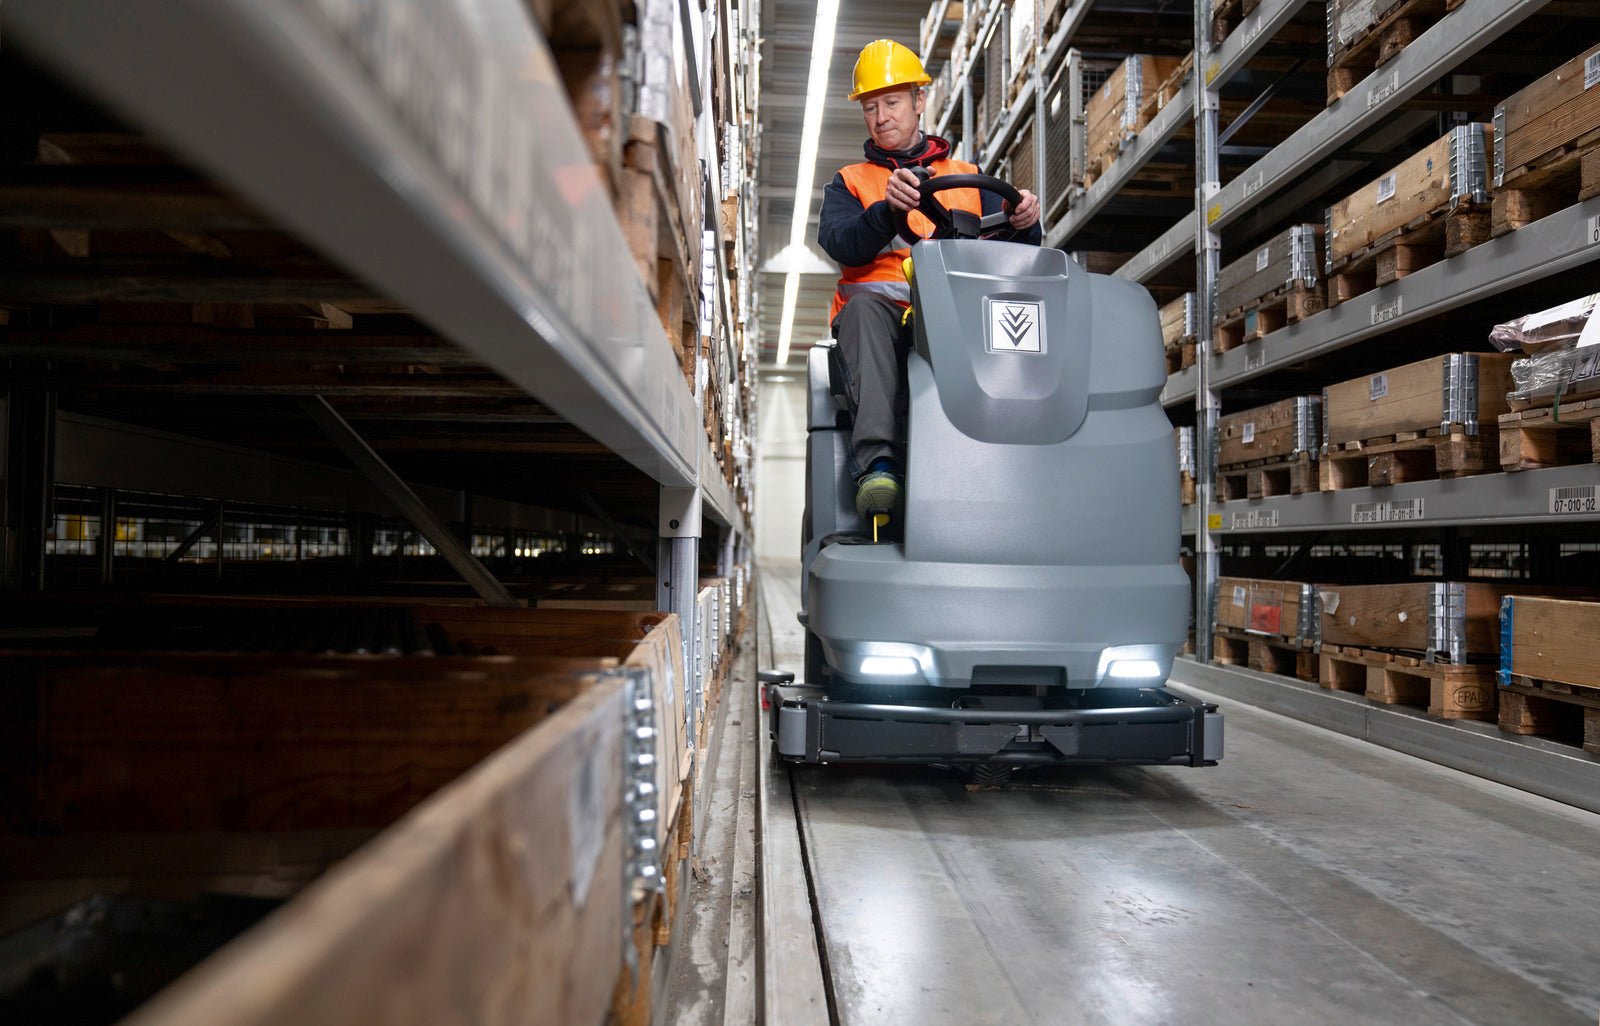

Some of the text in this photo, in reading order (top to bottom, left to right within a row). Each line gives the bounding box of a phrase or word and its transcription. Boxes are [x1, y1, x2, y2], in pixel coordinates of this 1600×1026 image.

[1554, 497, 1596, 513] 07-010-02
[1389, 508, 1415, 521] 07-011-01
[1457, 689, 1485, 704] EPAL
